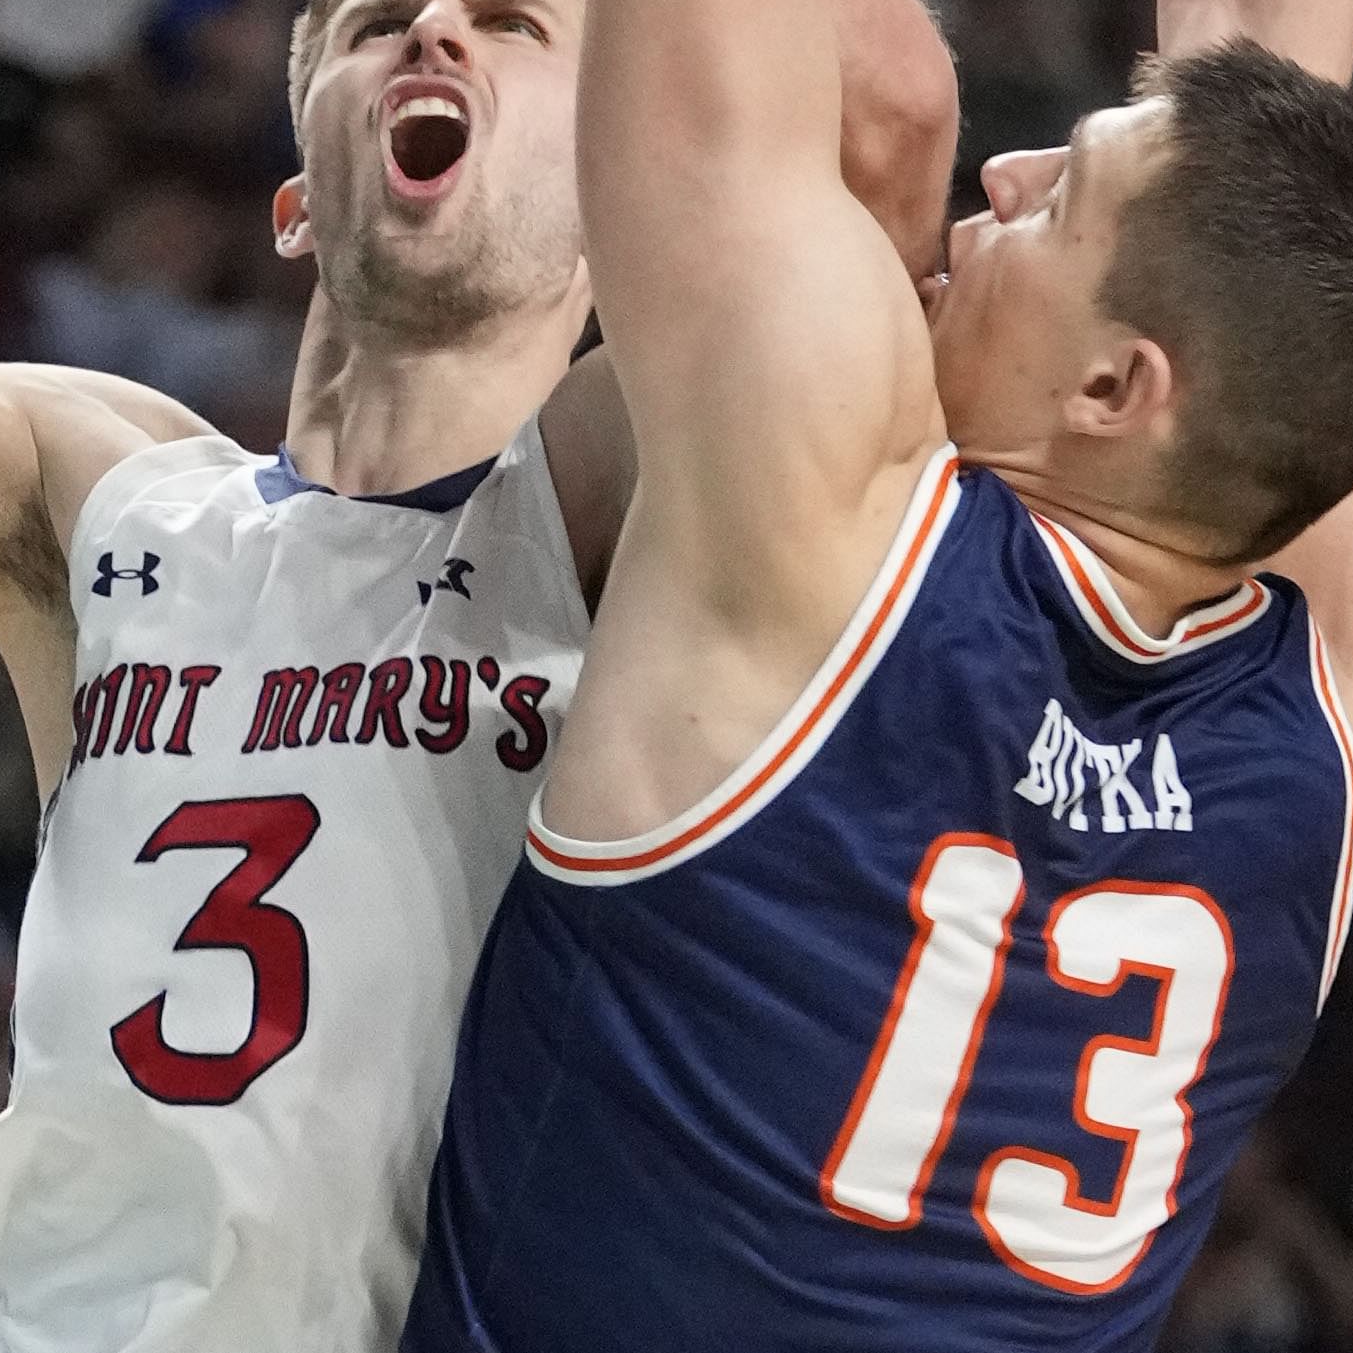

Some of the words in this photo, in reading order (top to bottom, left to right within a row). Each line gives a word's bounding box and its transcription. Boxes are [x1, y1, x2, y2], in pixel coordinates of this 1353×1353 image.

[67, 662, 222, 780] AINT
[241, 655, 551, 773] MARY'S
[111, 792, 321, 1106] 3
[820, 831, 1235, 1295] 13
